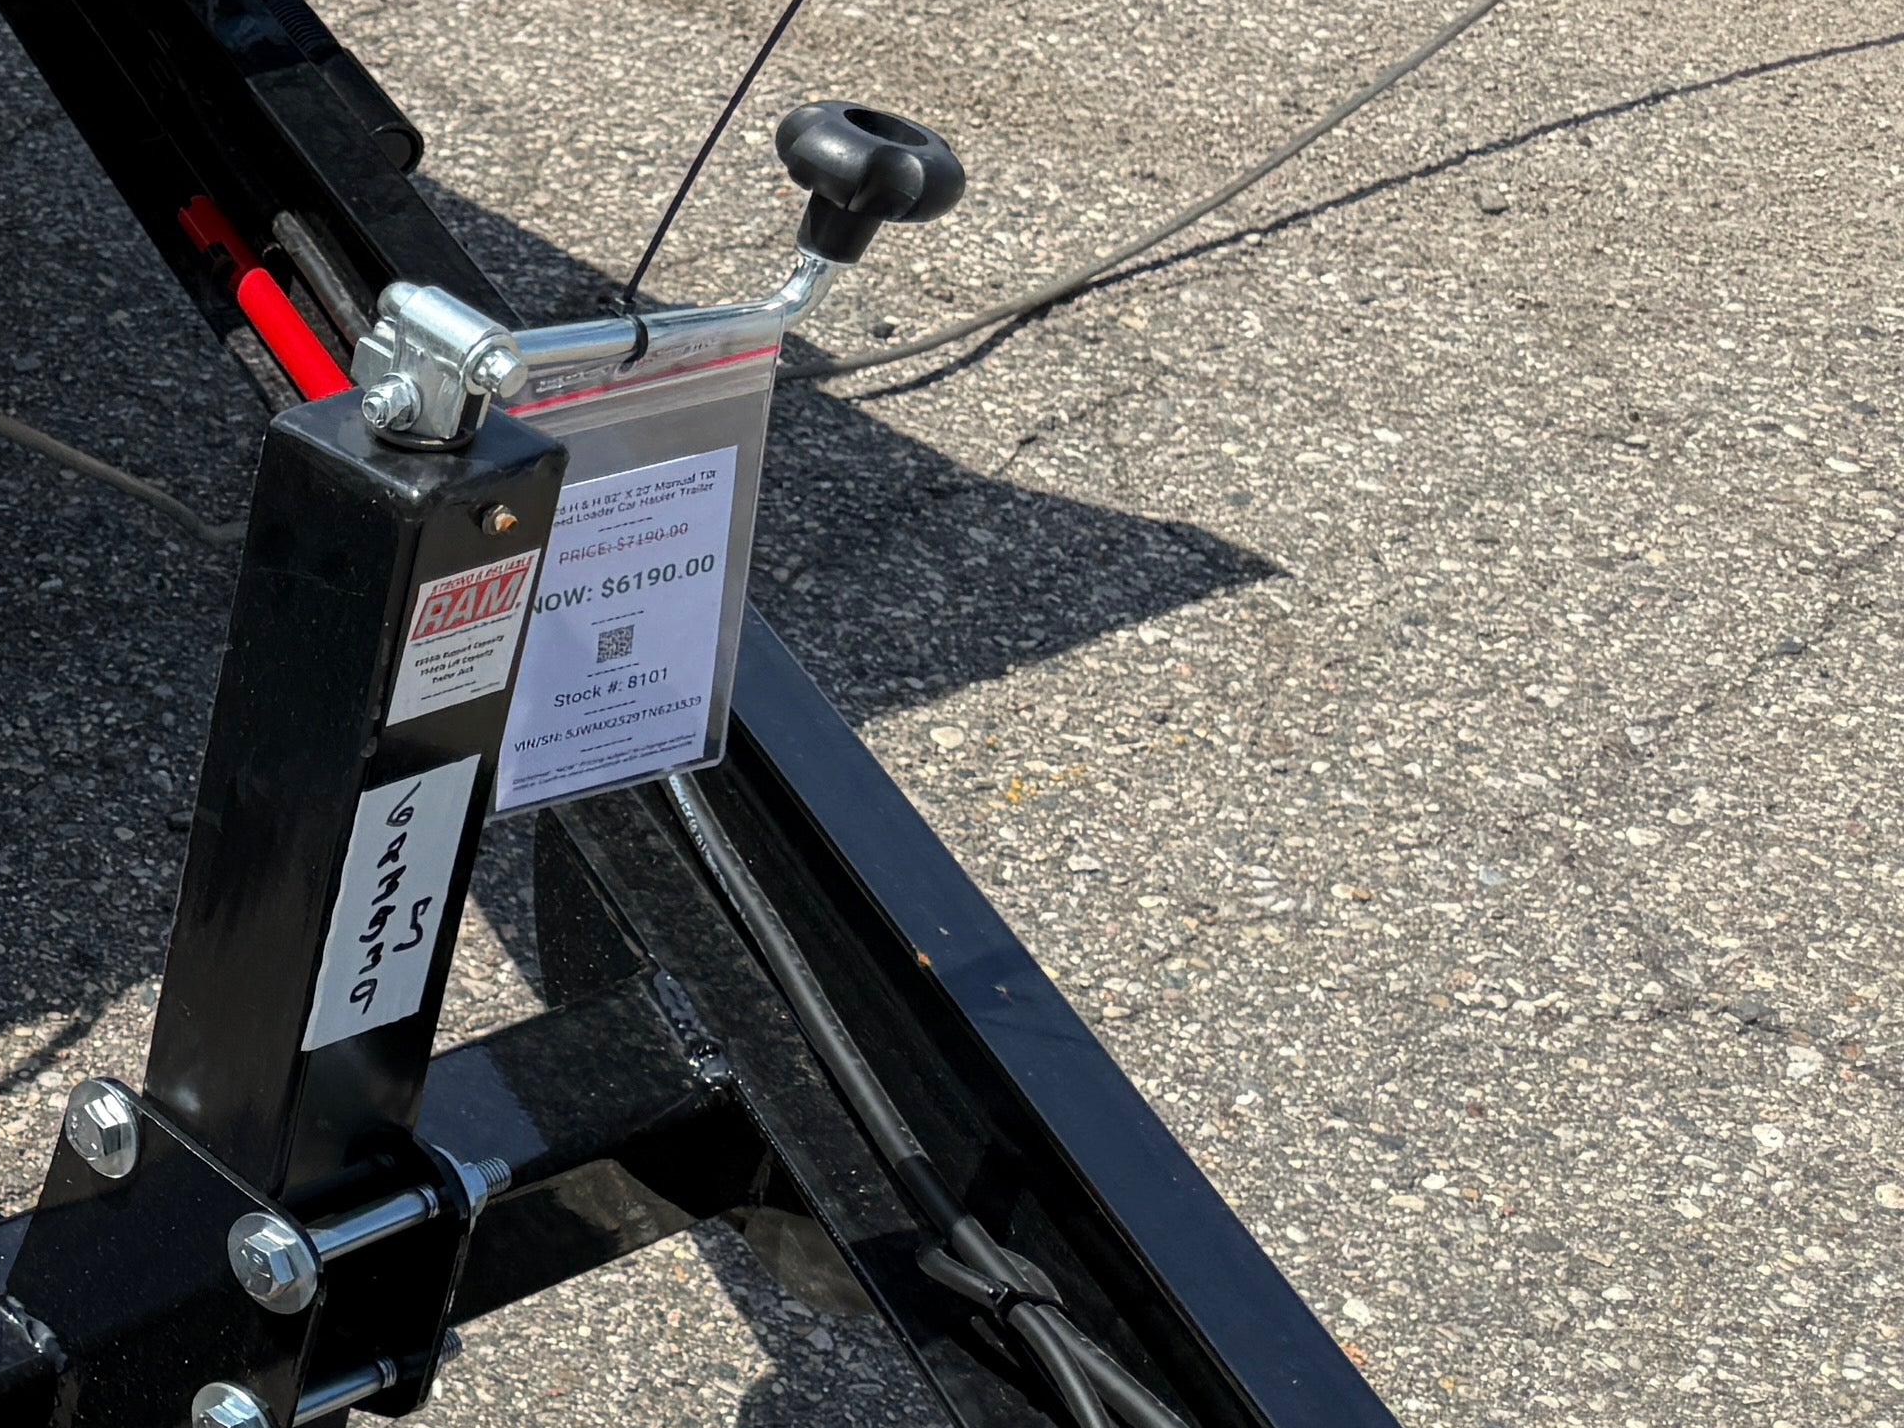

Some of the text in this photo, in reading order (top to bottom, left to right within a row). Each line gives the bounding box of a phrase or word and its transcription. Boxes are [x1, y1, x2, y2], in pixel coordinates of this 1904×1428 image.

[576, 504, 614, 522] Loader
[617, 499, 635, 512] Car
[679, 481, 713, 497] Trailer
[600, 553, 715, 599] $6190.00
[414, 574, 525, 640] RAM
[553, 667, 668, 708] Stock #: 8101
[514, 732, 562, 753] VIN/SN:
